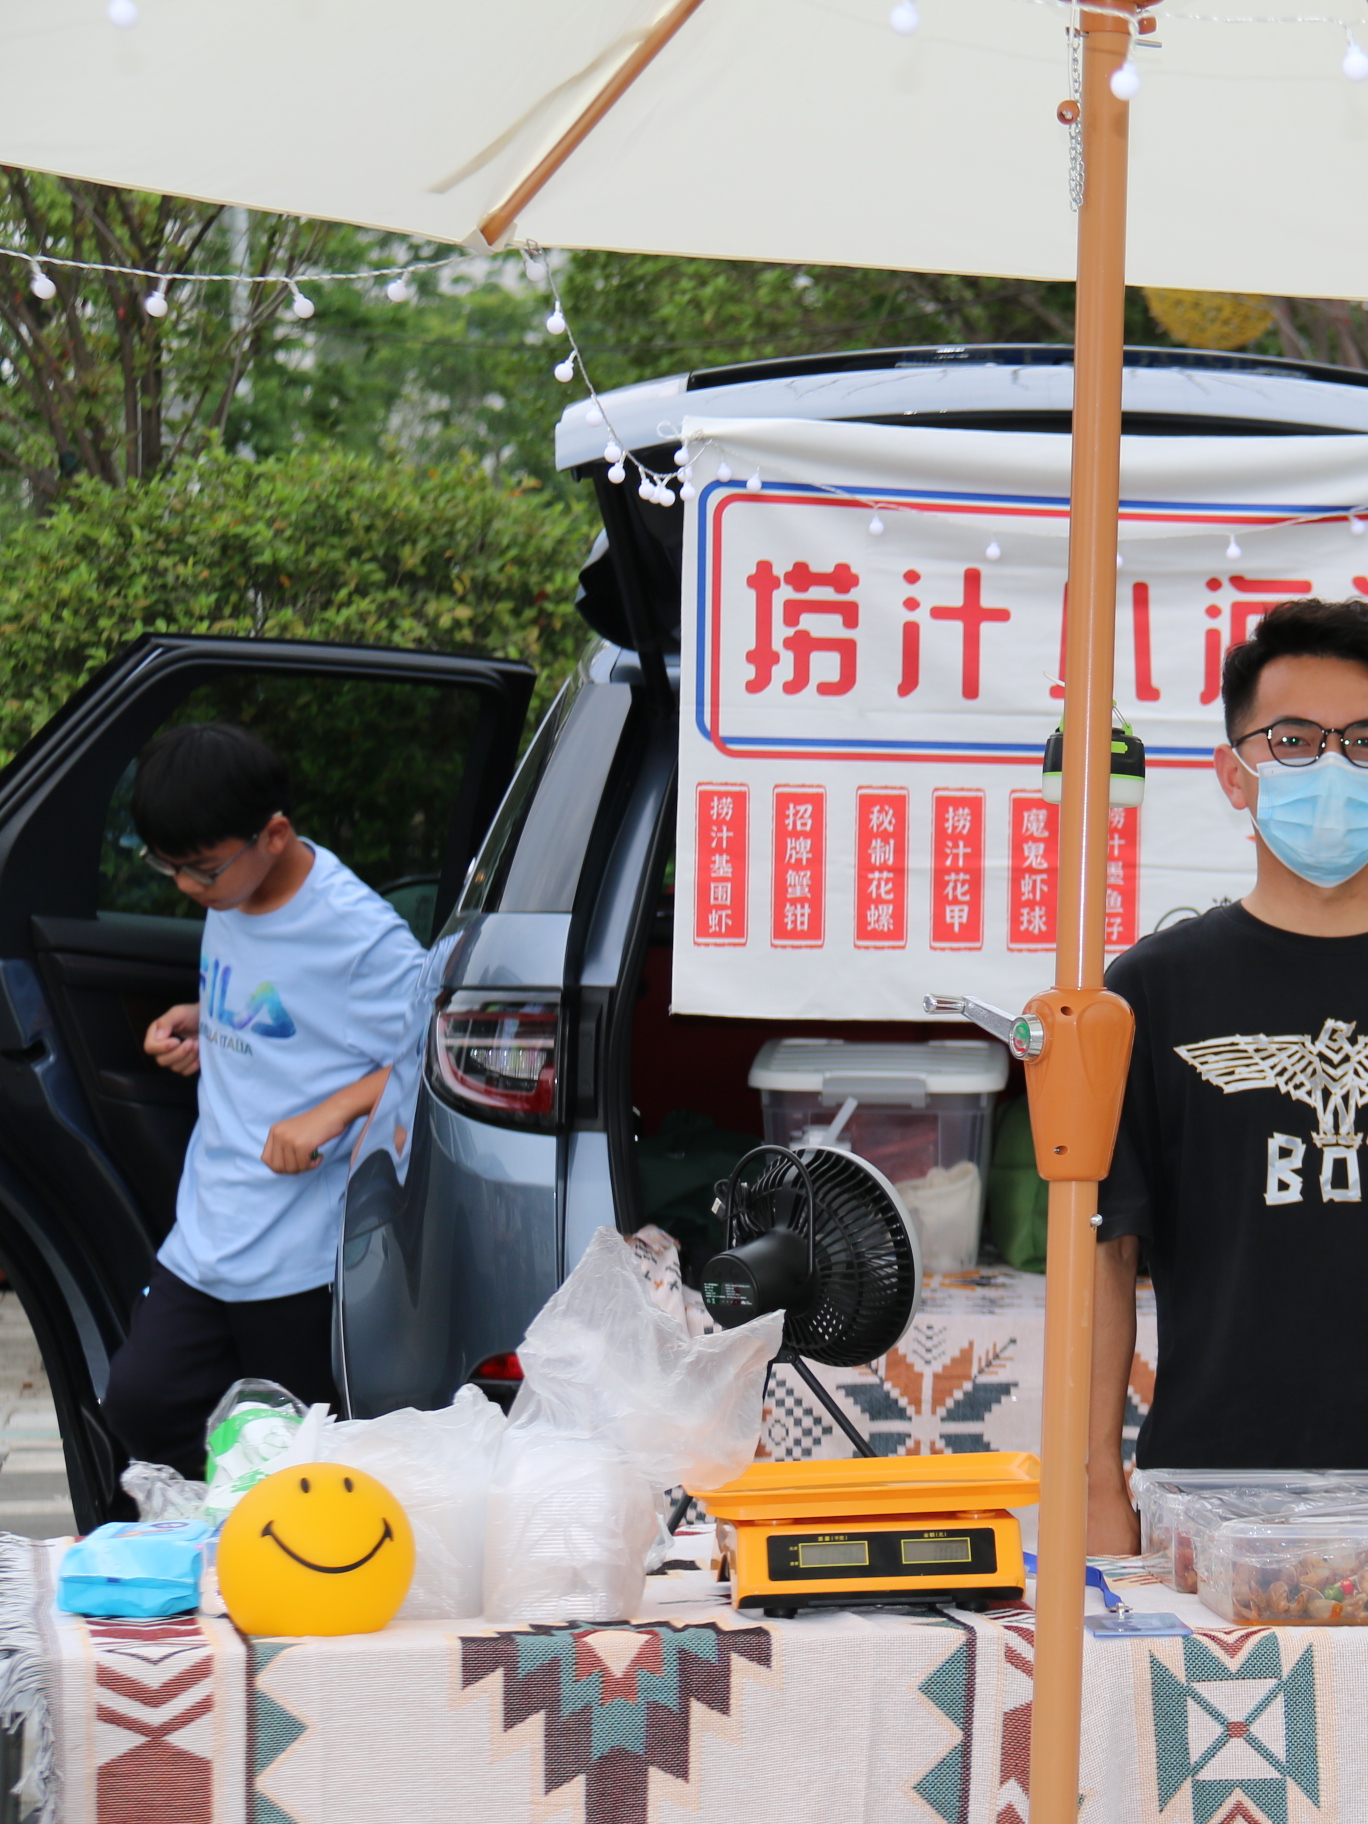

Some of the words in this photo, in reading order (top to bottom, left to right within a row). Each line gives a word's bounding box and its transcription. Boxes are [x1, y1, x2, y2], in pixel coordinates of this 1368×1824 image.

[708, 795, 734, 934] 捞汁基围虾
[783, 803, 813, 932] 招牌蟹钳
[866, 804, 896, 933] 秘制花螺
[943, 806, 972, 934] 捞汁花甲
[1019, 807, 1050, 935] 魔鬼虾球
[219, 1034, 254, 1057] ITALIA
